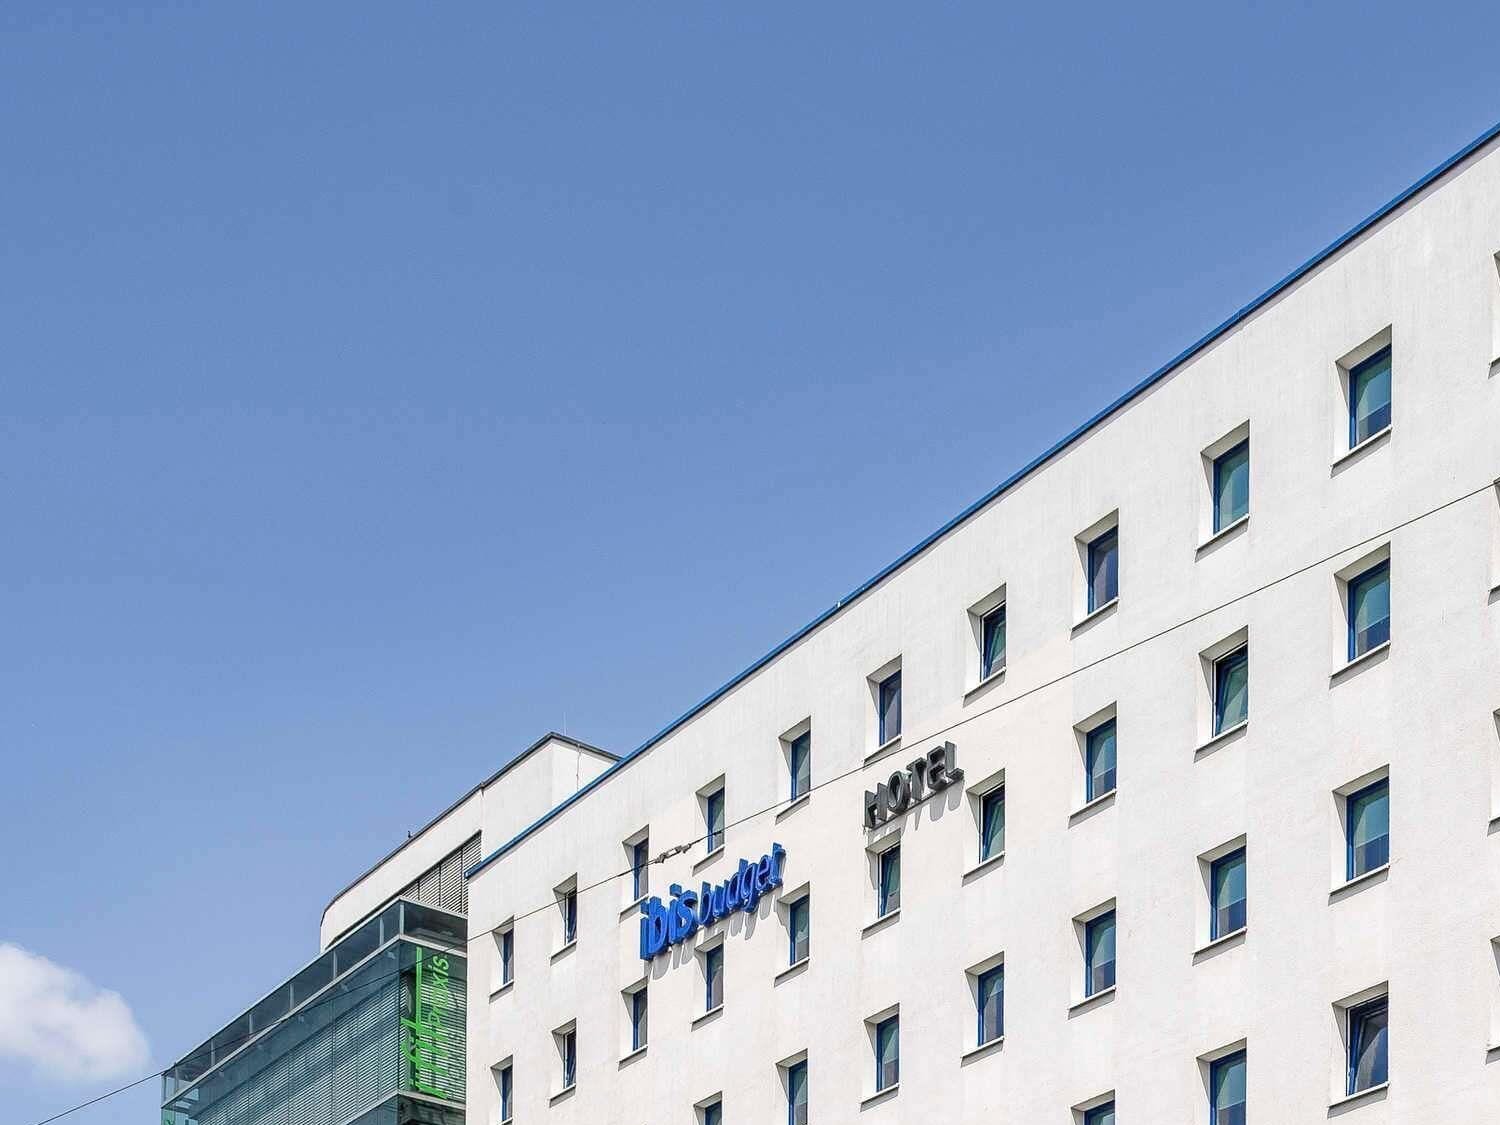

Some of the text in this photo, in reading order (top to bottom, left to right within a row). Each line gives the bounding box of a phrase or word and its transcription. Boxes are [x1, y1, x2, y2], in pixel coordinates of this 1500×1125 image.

[864, 741, 964, 829] HOTEL
[640, 842, 787, 961] ibis budget
